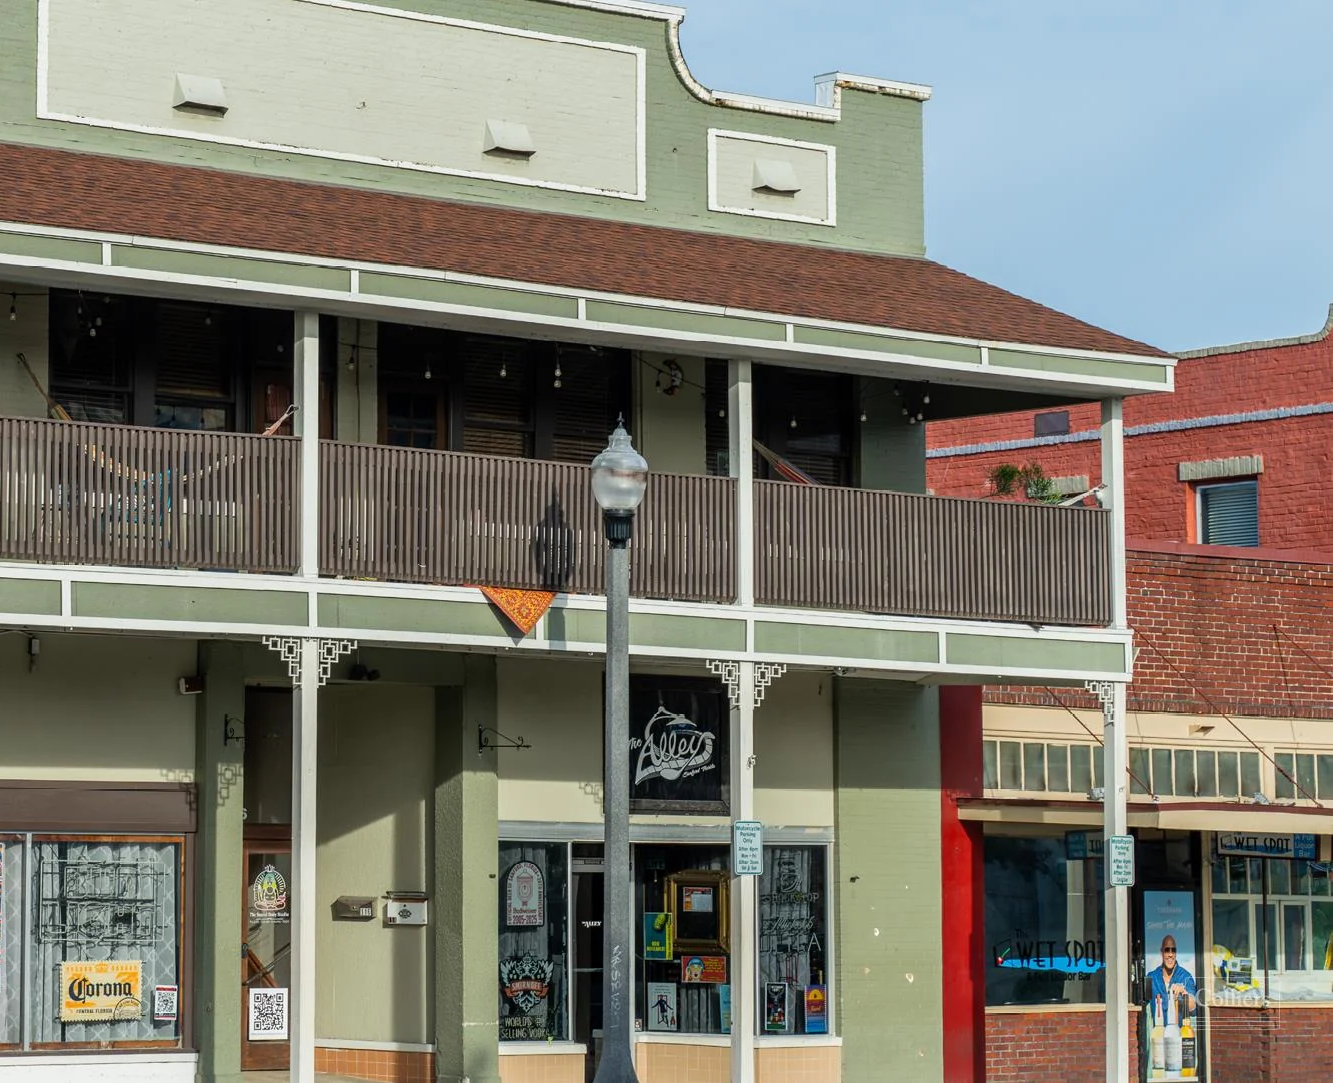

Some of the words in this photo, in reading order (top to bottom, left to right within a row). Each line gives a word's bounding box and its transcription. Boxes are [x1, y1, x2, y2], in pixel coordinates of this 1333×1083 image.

[629, 737, 642, 750] The
[635, 730, 716, 785] Alley
[1233, 836, 1258, 850] WET
[1263, 837, 1291, 851] SPOT
[1299, 849, 1310, 857] Bar
[512, 914, 538, 924] 2005-2025
[1017, 940, 1056, 968] WET
[1065, 940, 1106, 968] SPOT
[1078, 971, 1091, 980] Bar
[69, 976, 134, 1004] Corona
[511, 980, 542, 991] SMIRNOFF
[504, 1016, 532, 1027] WORLD'S
[501, 1027, 527, 1039] SELLING
